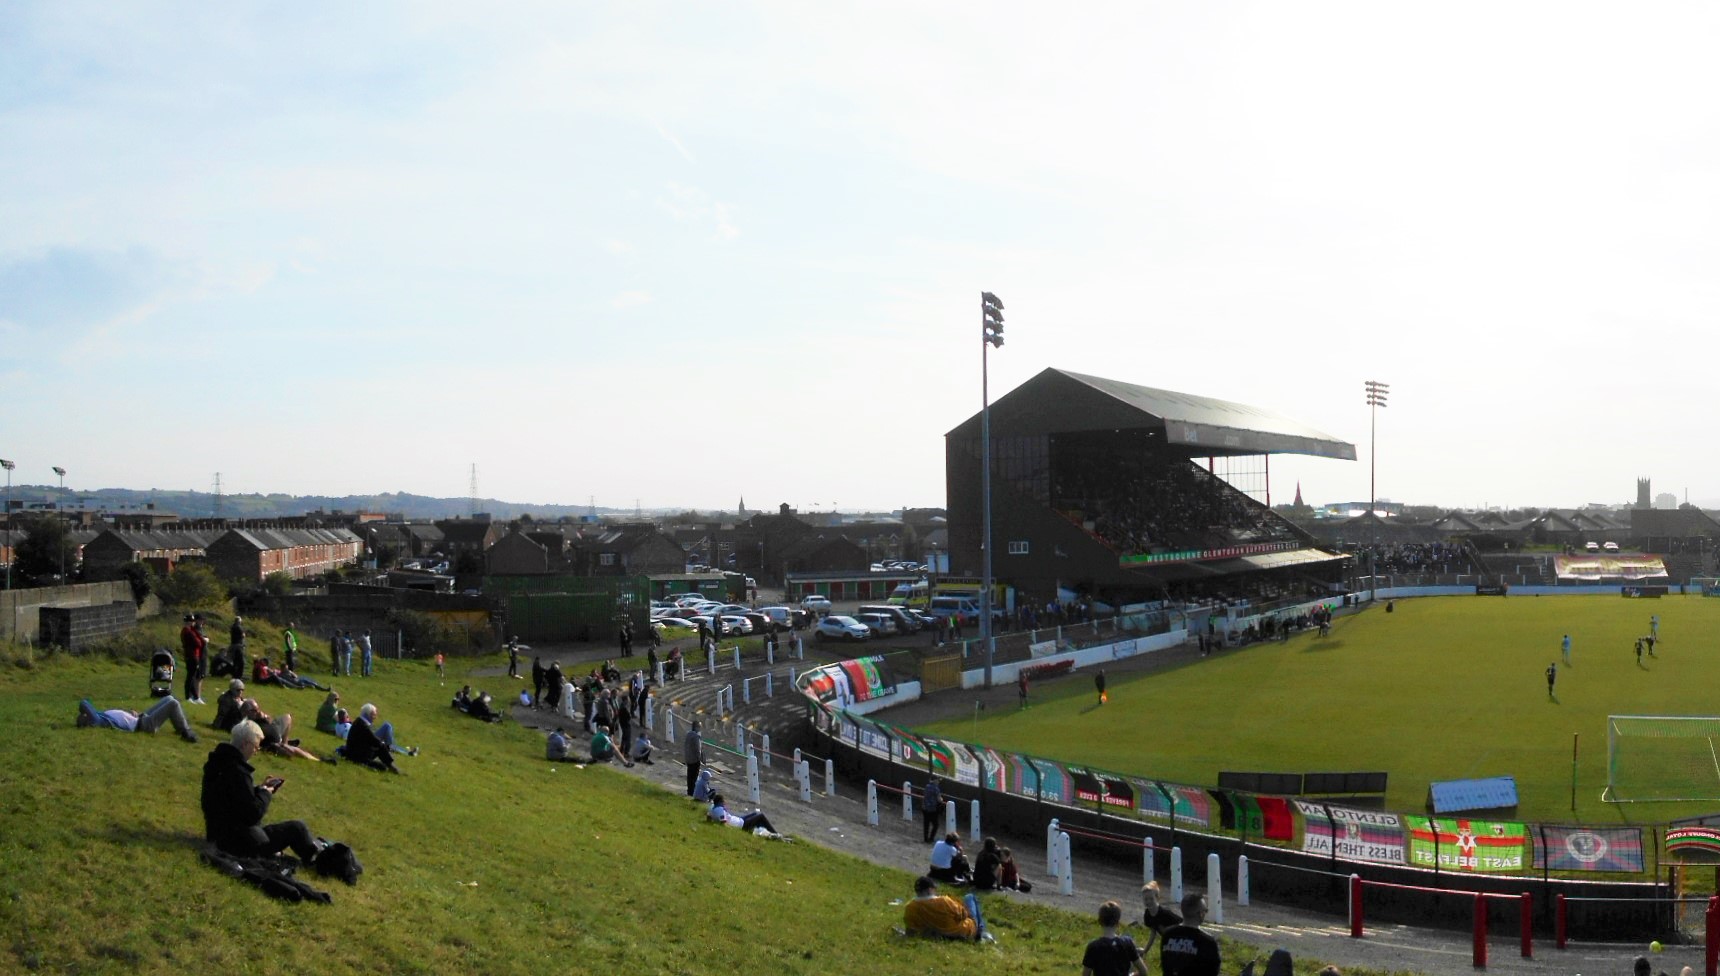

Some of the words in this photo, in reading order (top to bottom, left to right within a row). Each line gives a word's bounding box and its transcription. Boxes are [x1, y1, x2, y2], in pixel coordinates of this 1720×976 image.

[1147, 551, 1201, 563] WESTBOURNE
[1203, 547, 1244, 559] GLENTORAN
[1245, 543, 1284, 554] SUPPORTERS
